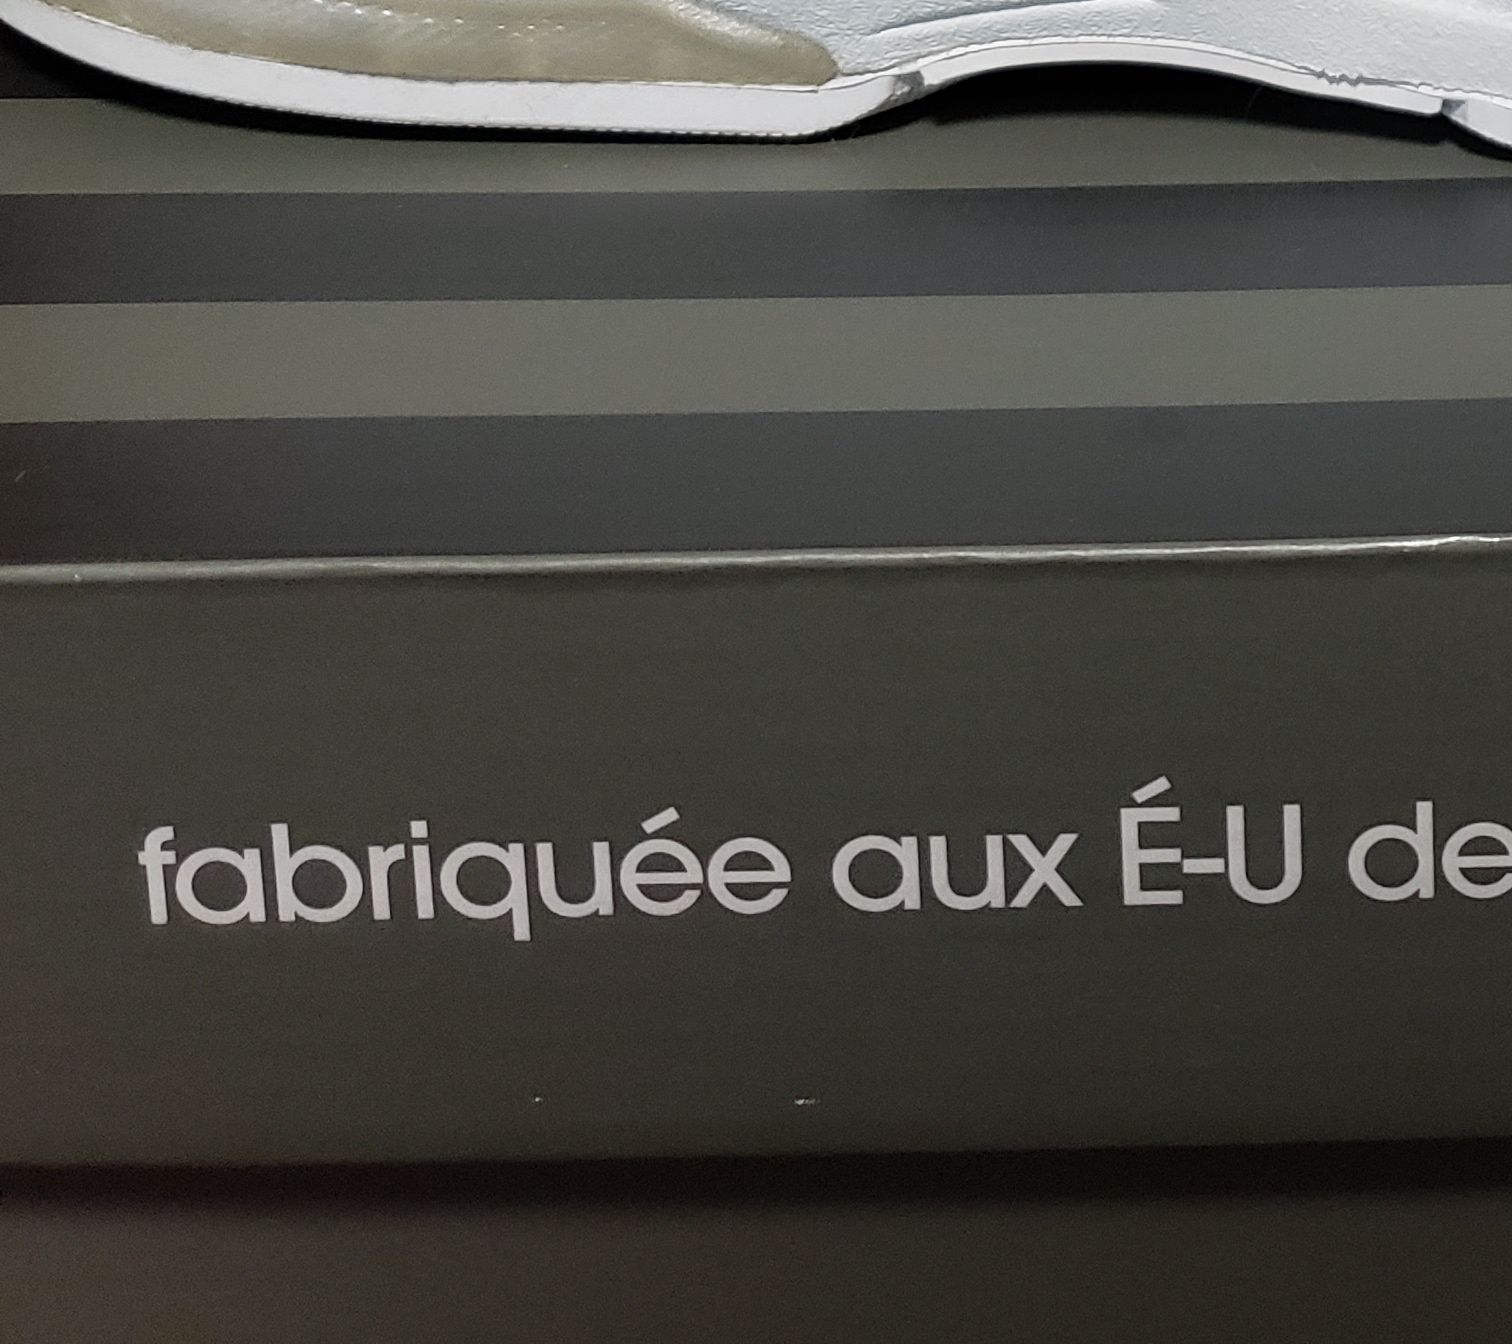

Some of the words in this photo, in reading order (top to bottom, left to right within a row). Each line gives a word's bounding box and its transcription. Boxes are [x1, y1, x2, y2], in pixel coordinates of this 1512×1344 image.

[138, 806, 791, 942] fabriquée
[832, 833, 1083, 913] aux
[1120, 775, 1303, 906] É-U
